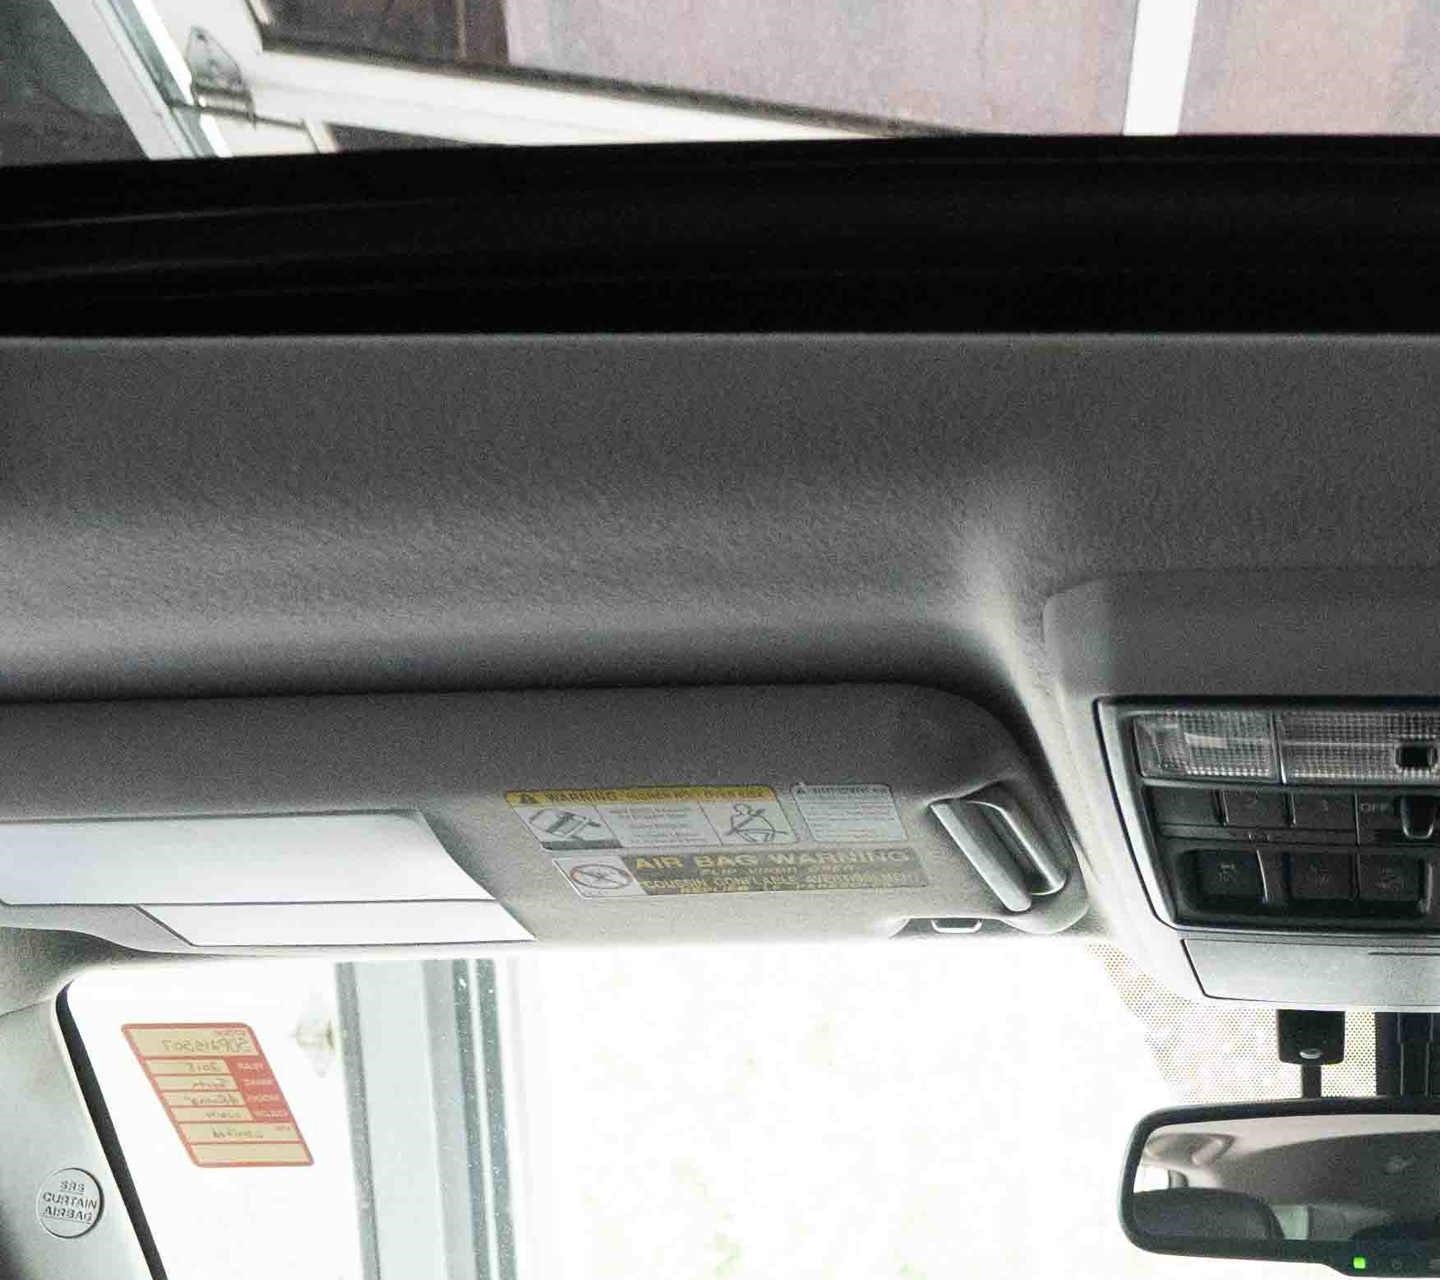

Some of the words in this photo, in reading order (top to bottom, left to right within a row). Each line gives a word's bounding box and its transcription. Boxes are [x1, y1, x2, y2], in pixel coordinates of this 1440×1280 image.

[636, 856, 683, 869] AIR
[694, 854, 759, 867] BAG
[767, 851, 910, 865] WARNING
[60, 1180, 85, 1193] SRS
[42, 1191, 98, 1209] CURTAIN
[44, 1205, 93, 1222] AIRBAG
